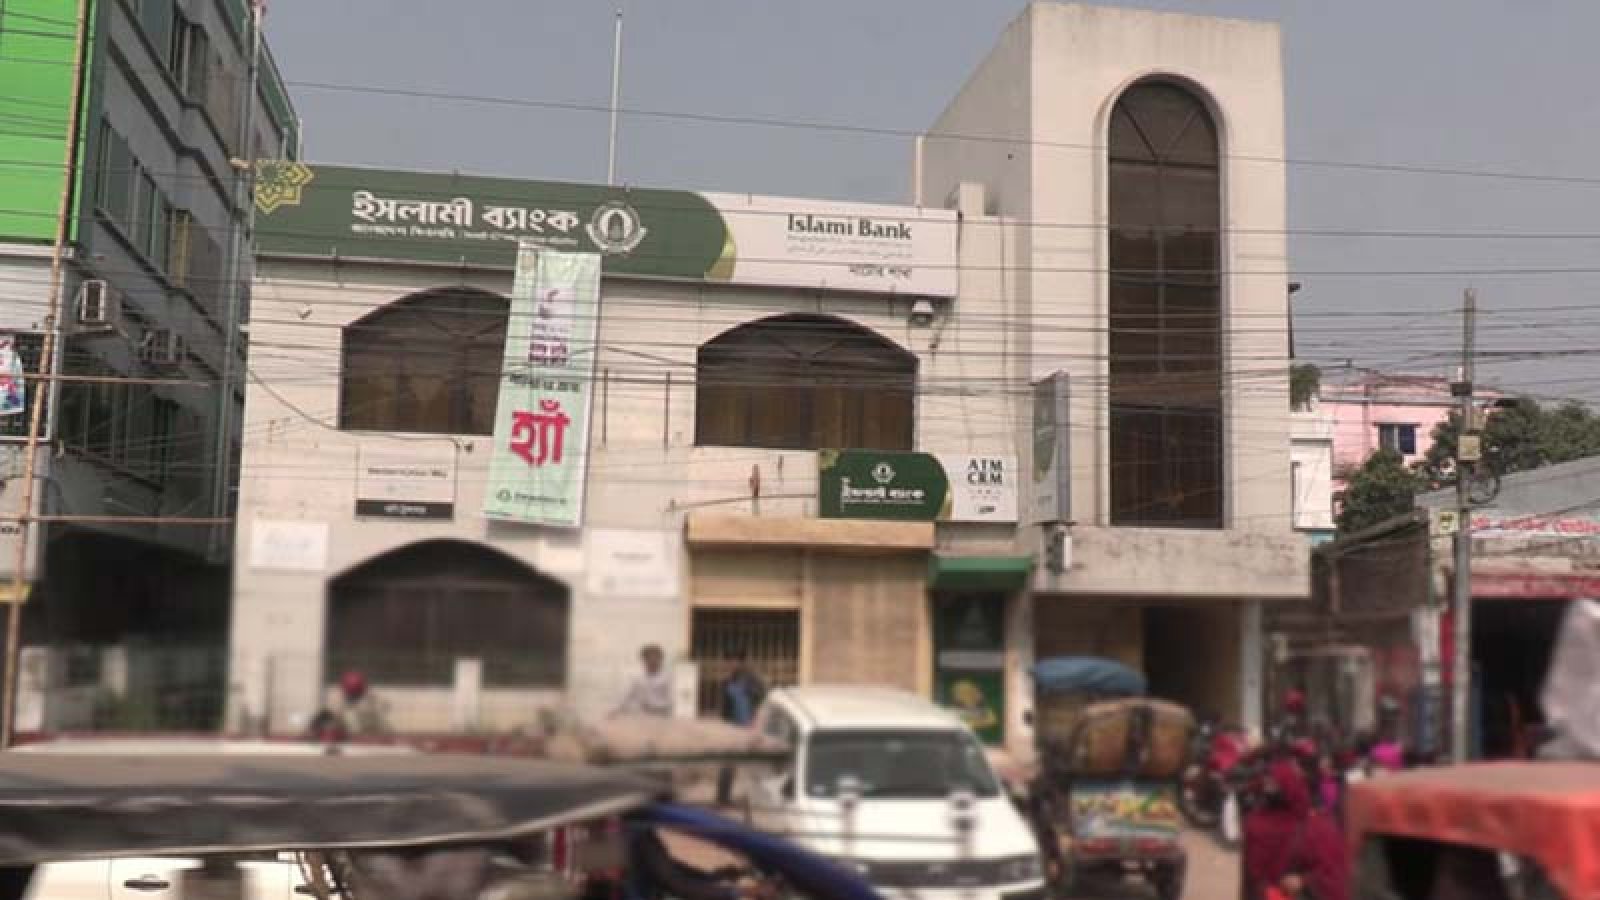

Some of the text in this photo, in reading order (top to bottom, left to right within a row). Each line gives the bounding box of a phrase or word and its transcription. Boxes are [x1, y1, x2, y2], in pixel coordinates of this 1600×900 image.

[352, 190, 580, 233] ইসলামী ব্যাংক
[787, 213, 912, 240] Islami Bank
[510, 399, 571, 467] হ্যাঁ
[967, 459, 1003, 471] ATM
[967, 471, 1003, 485] CRM
